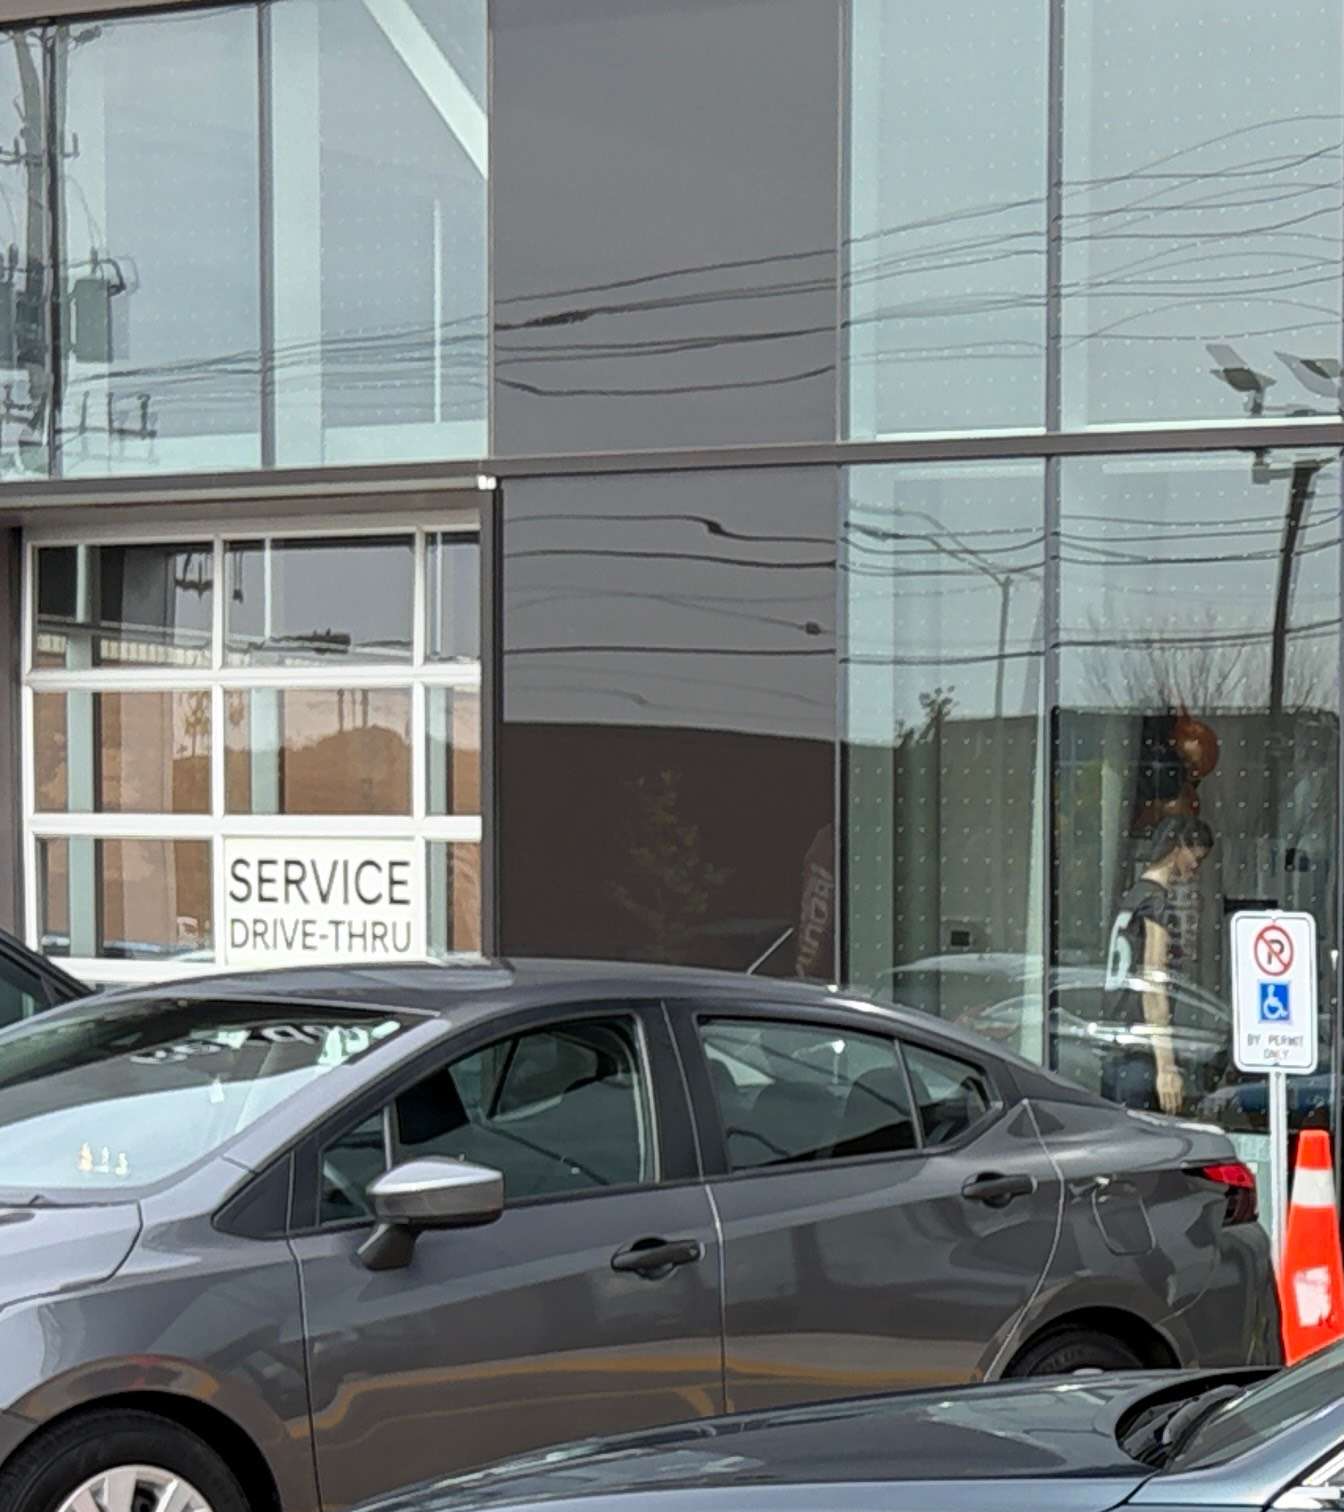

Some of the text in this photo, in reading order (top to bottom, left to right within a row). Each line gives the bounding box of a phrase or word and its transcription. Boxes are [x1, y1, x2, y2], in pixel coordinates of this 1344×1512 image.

[228, 858, 412, 906] SERVICE
[229, 918, 412, 954] DRIVE-THRU
[1247, 1033, 1304, 1048] BY PERMIT
[1264, 1048, 1290, 1060] ONLY
